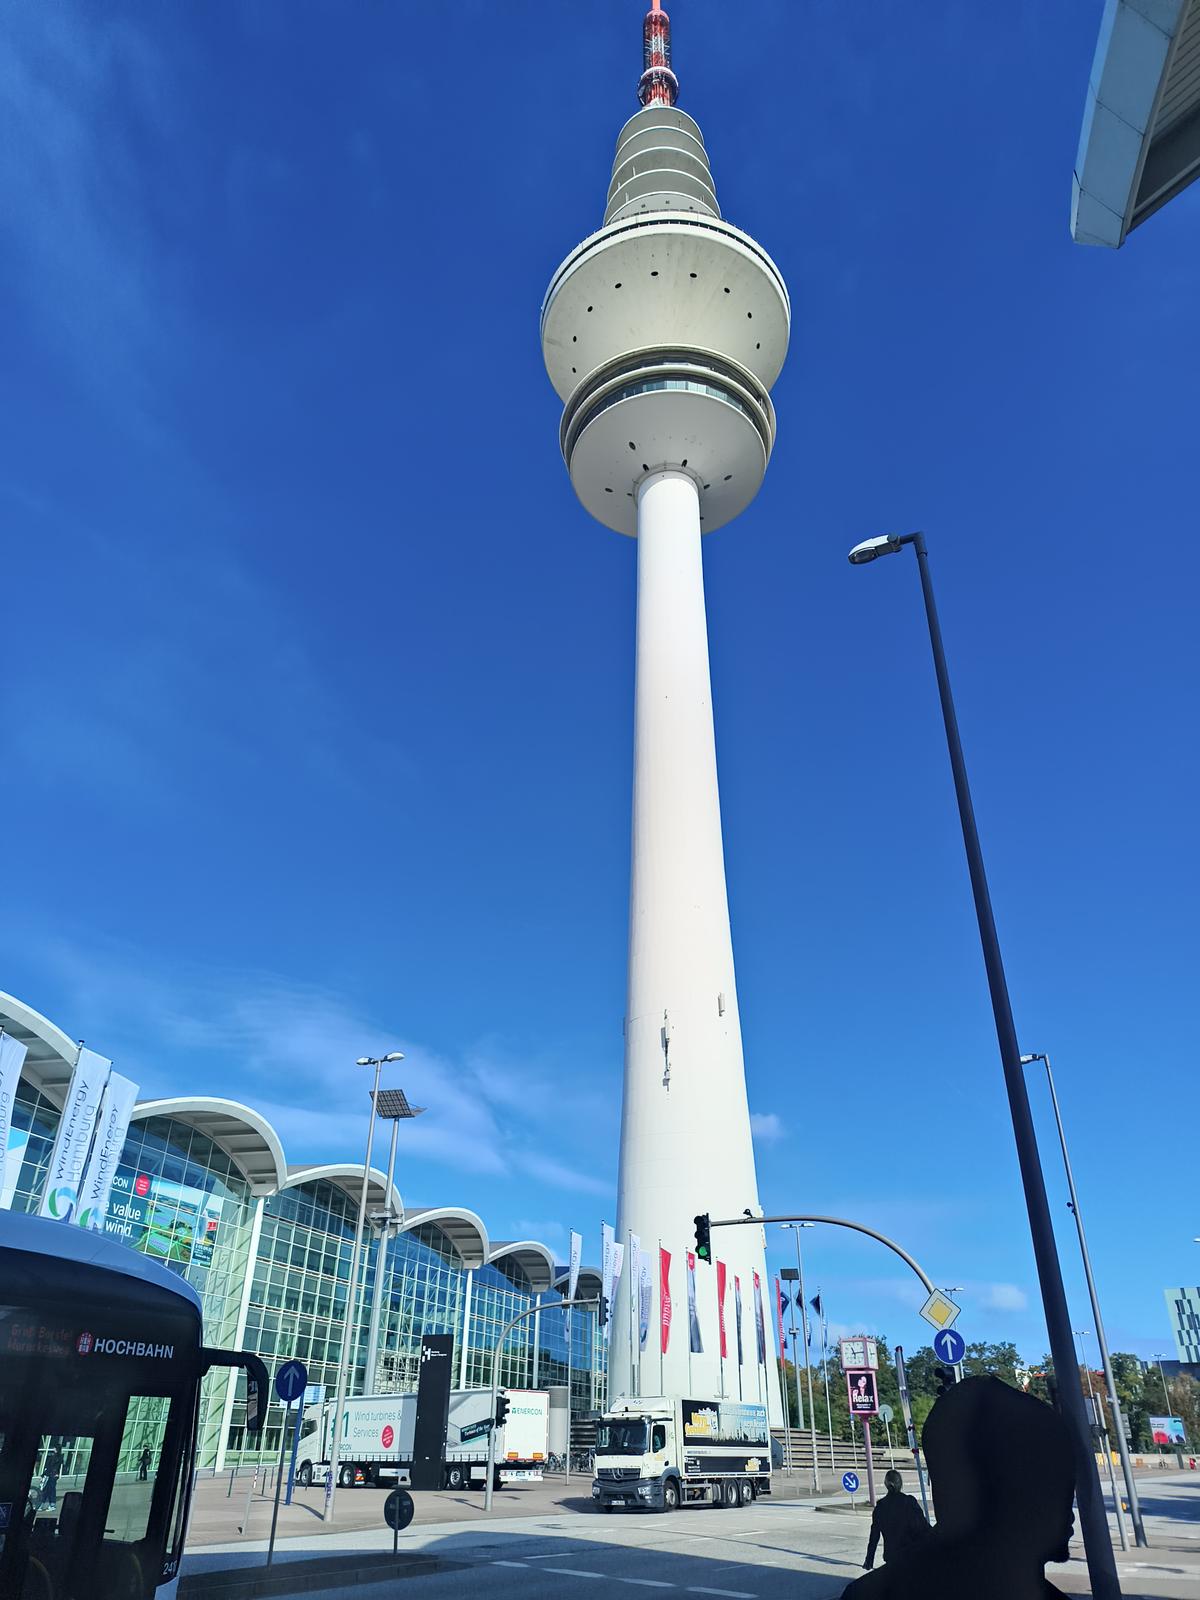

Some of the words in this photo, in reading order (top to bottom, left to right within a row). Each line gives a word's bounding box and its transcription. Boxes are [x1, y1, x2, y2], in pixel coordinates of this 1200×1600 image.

[55, 1080, 90, 1180] WindEnergy
[66, 1105, 97, 1183] Hamburg
[112, 1175, 129, 1189] CON
[113, 1203, 141, 1220] value
[105, 1220, 133, 1238] wind.
[94, 1338, 174, 1359] HOCHBAHN
[852, 1393, 874, 1403] Relax
[354, 1411, 370, 1421] Wind
[370, 1411, 396, 1421] turbines
[353, 1427, 379, 1438] Services
